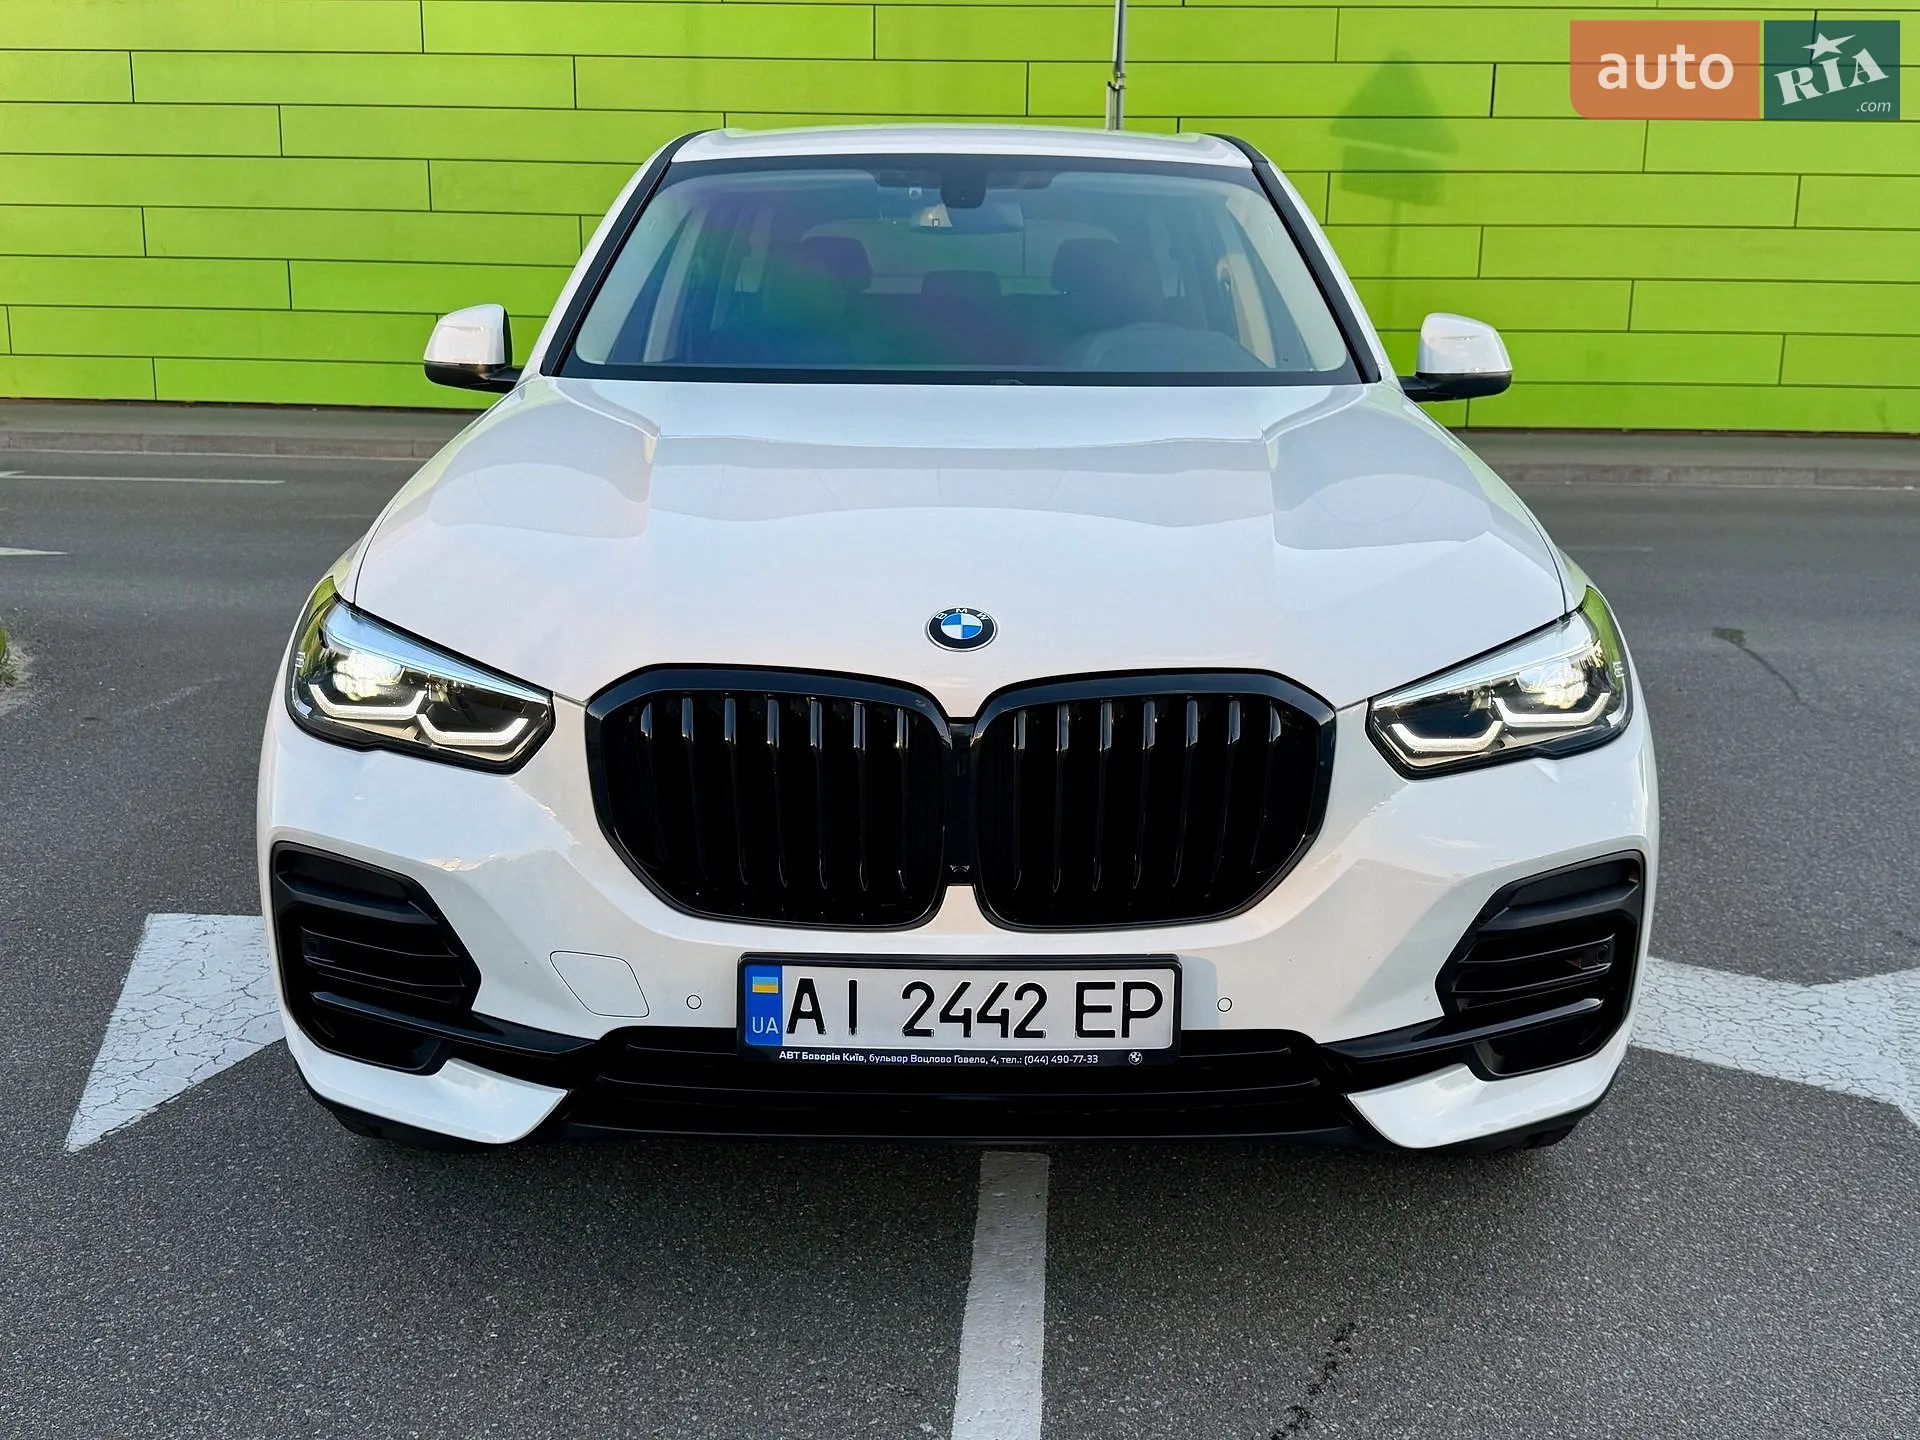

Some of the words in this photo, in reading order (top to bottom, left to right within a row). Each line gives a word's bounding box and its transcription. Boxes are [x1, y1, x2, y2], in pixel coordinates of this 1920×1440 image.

[935, 608, 989, 620] BMW
[786, 977, 857, 1035] AI
[902, 981, 1047, 1038] 2442
[1075, 981, 1164, 1038] EP
[752, 1017, 779, 1034] UA
[1024, 1054, 1049, 1065] (044)
[1050, 1054, 1099, 1065] 490-77-33
